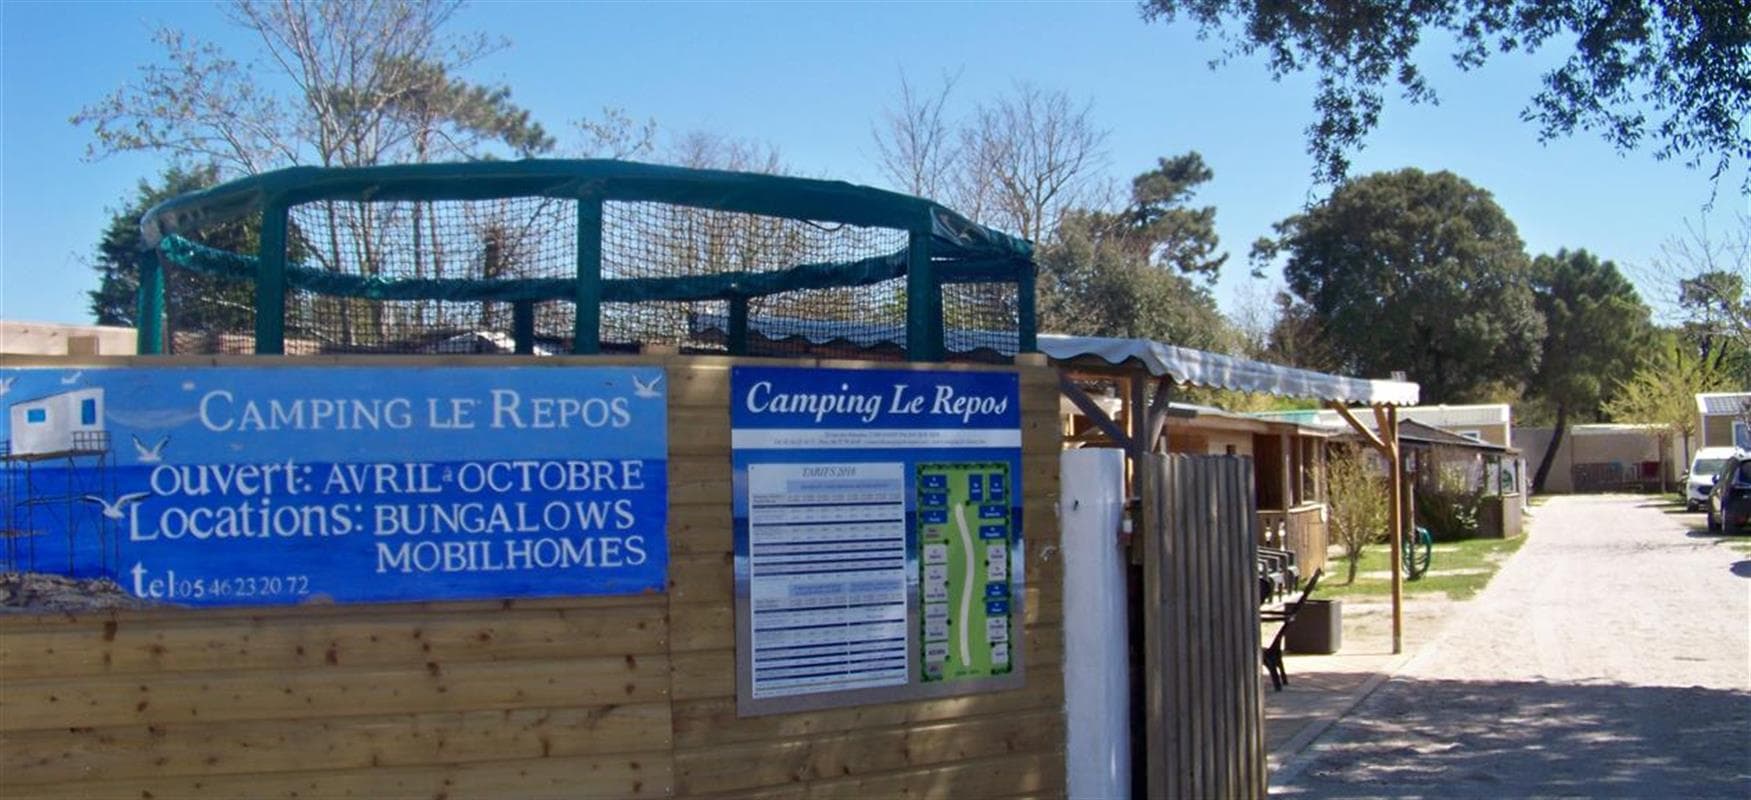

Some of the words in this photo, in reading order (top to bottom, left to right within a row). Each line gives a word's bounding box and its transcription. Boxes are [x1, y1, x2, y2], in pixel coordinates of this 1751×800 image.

[201, 390, 412, 431] CAMPING
[429, 399, 476, 429] LE
[490, 389, 631, 428] REPOS
[747, 381, 882, 422] Camping
[888, 384, 924, 415] Le
[930, 385, 1007, 423] Repos
[150, 459, 313, 496] ouvert:
[323, 463, 442, 494] AVRIL
[457, 460, 645, 493] OCTOBRE
[130, 498, 363, 541] Locations:
[373, 499, 636, 535] BUNGALOWS
[375, 535, 647, 573] MOBILHOMES
[179, 579, 205, 598] 05
[208, 579, 231, 596] 46
[234, 577, 256, 596] 23
[259, 576, 282, 595] 20
[286, 575, 310, 594] 72
